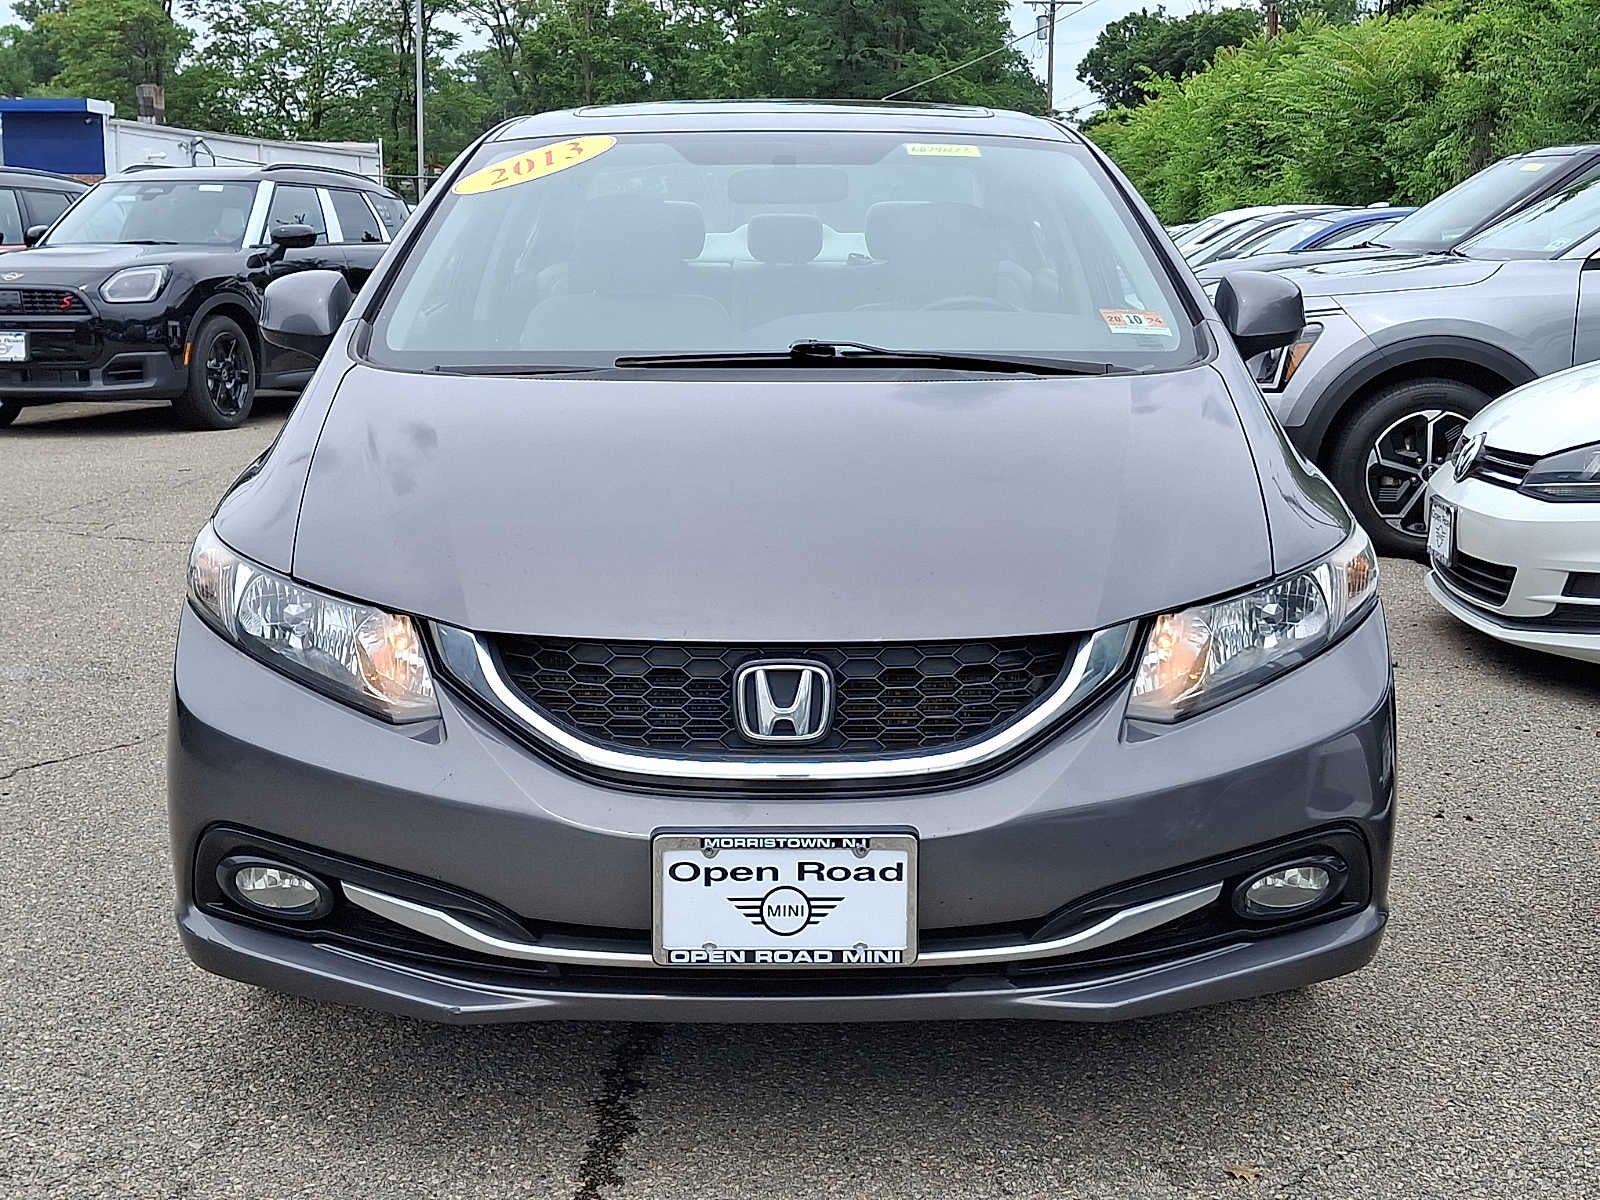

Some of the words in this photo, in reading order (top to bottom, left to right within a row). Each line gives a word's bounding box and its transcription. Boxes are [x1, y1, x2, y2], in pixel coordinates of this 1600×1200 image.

[490, 142, 584, 186] 2013
[60, 295, 74, 311] S
[1125, 313, 1143, 325] 10
[704, 838, 836, 849] MORRISTOWN,
[842, 838, 867, 849] NJ
[668, 861, 779, 887] Open
[797, 861, 904, 882] Road
[767, 904, 805, 917] MINI
[670, 950, 746, 964] OPEN
[755, 950, 833, 964] ROAD
[842, 950, 901, 964] MINI
